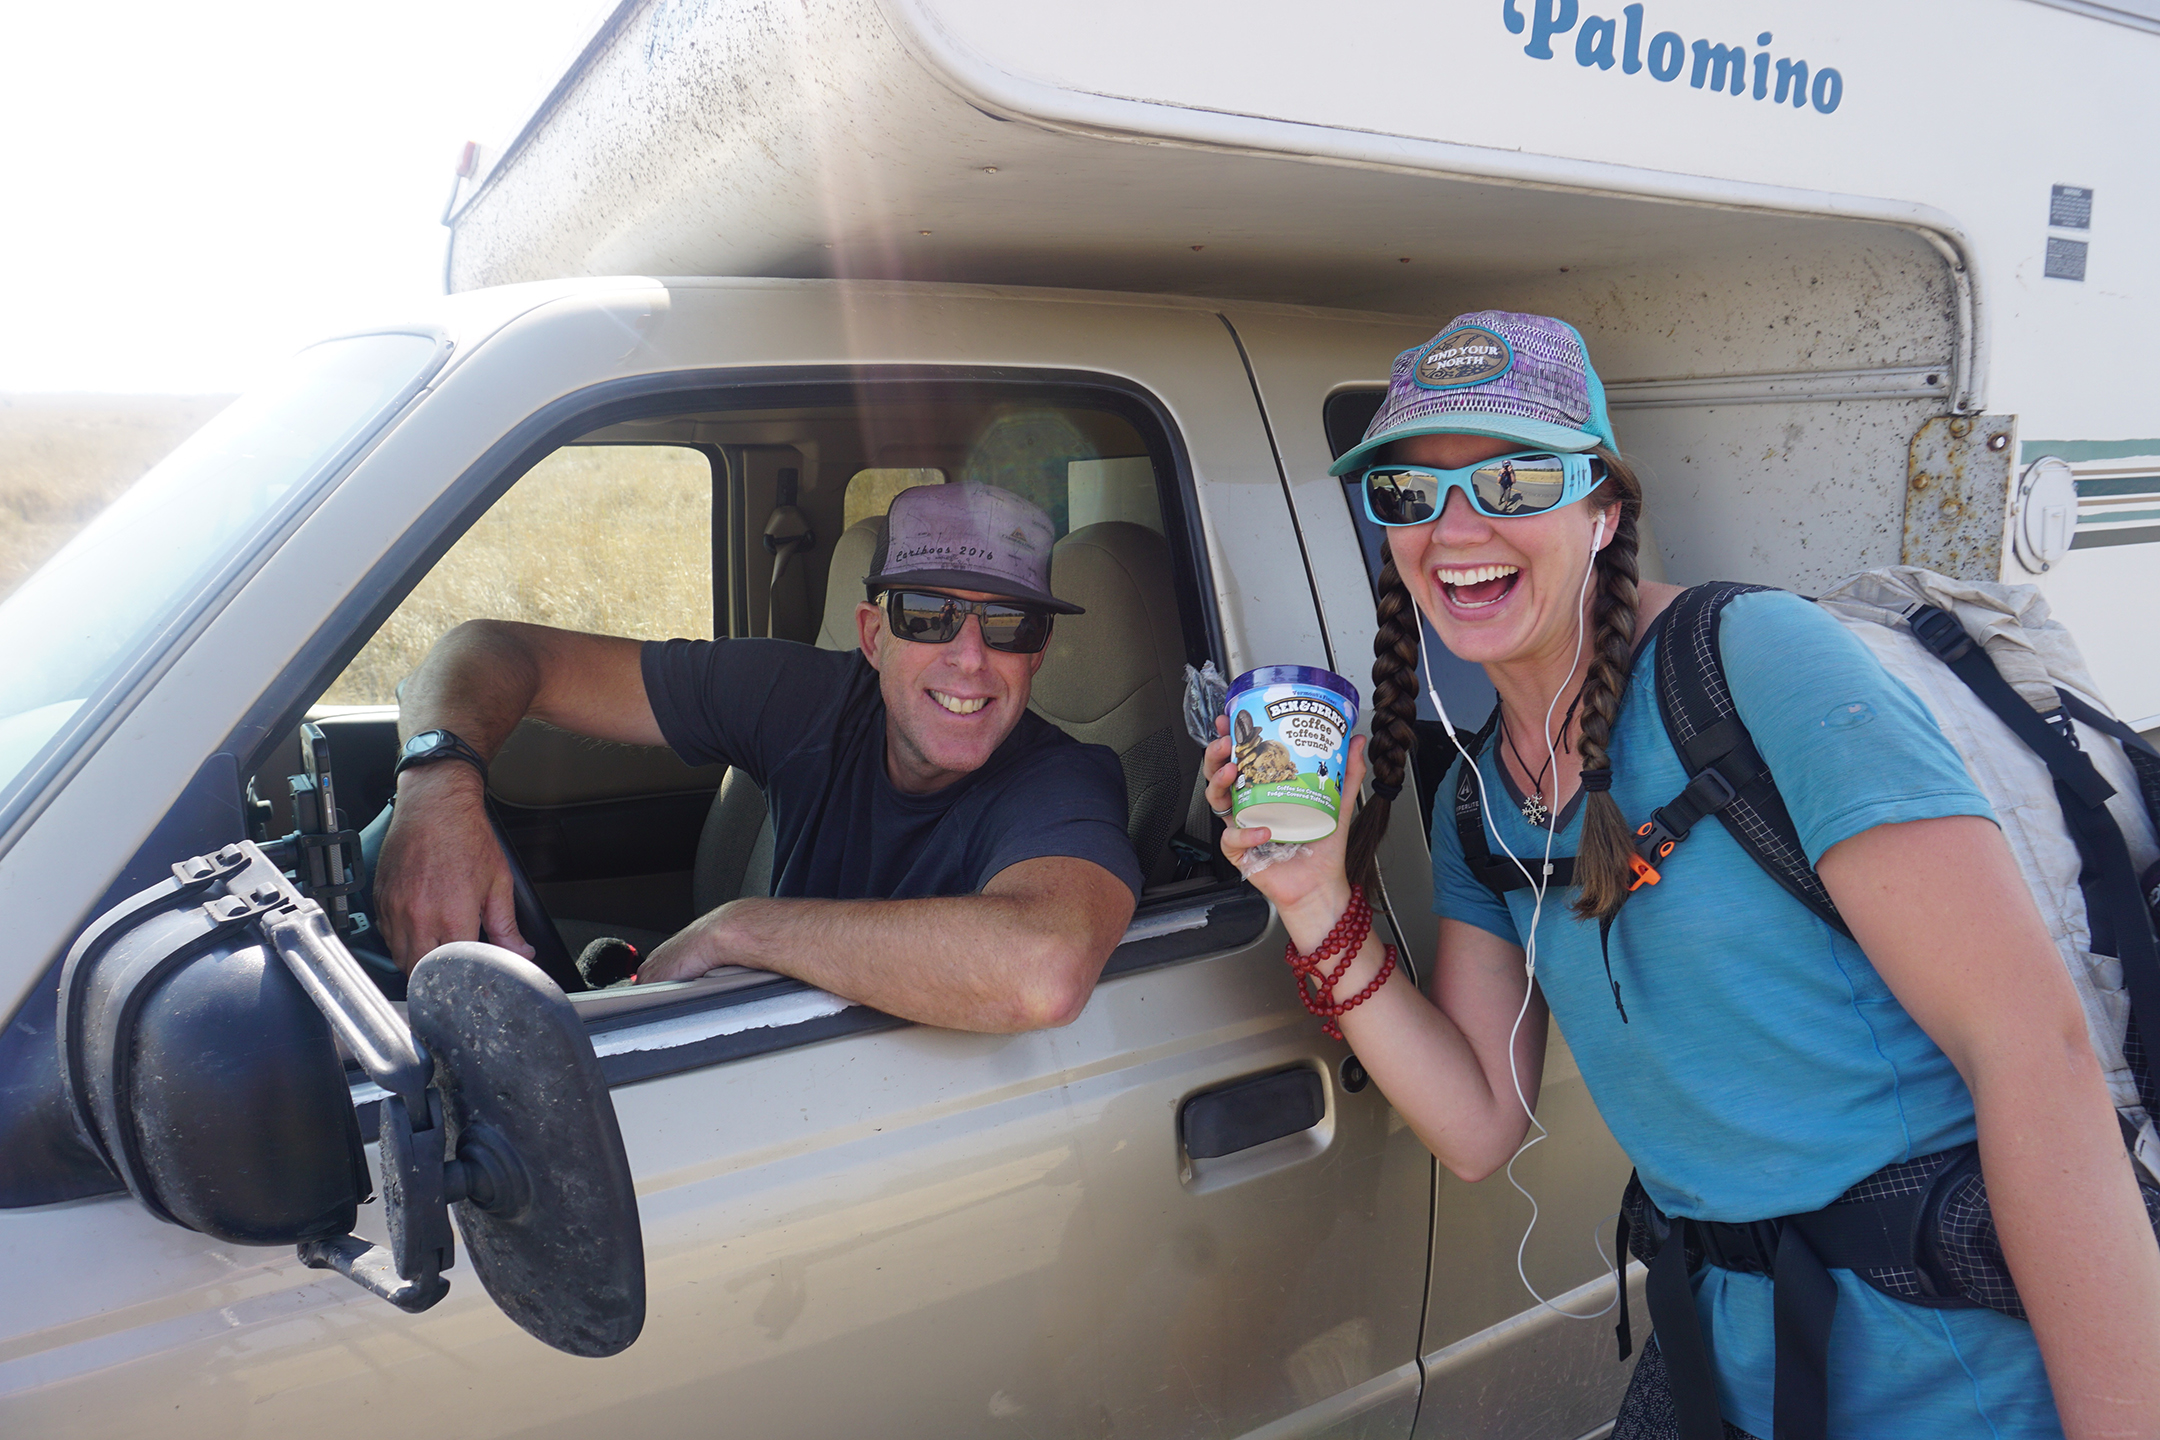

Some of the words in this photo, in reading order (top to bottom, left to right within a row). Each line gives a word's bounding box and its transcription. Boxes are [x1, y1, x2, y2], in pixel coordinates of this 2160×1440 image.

[1503, 0, 1843, 114] Palomino
[1426, 349, 1457, 364] FIND
[1459, 346, 1498, 355] YOUR
[1436, 356, 1484, 370] NORTH
[959, 546, 993, 560] 2016
[1292, 717, 1332, 735] Coffee
[1286, 729, 1319, 740] Toffee
[1319, 733, 1334, 747] Bar
[1294, 738, 1329, 752] Crunch
